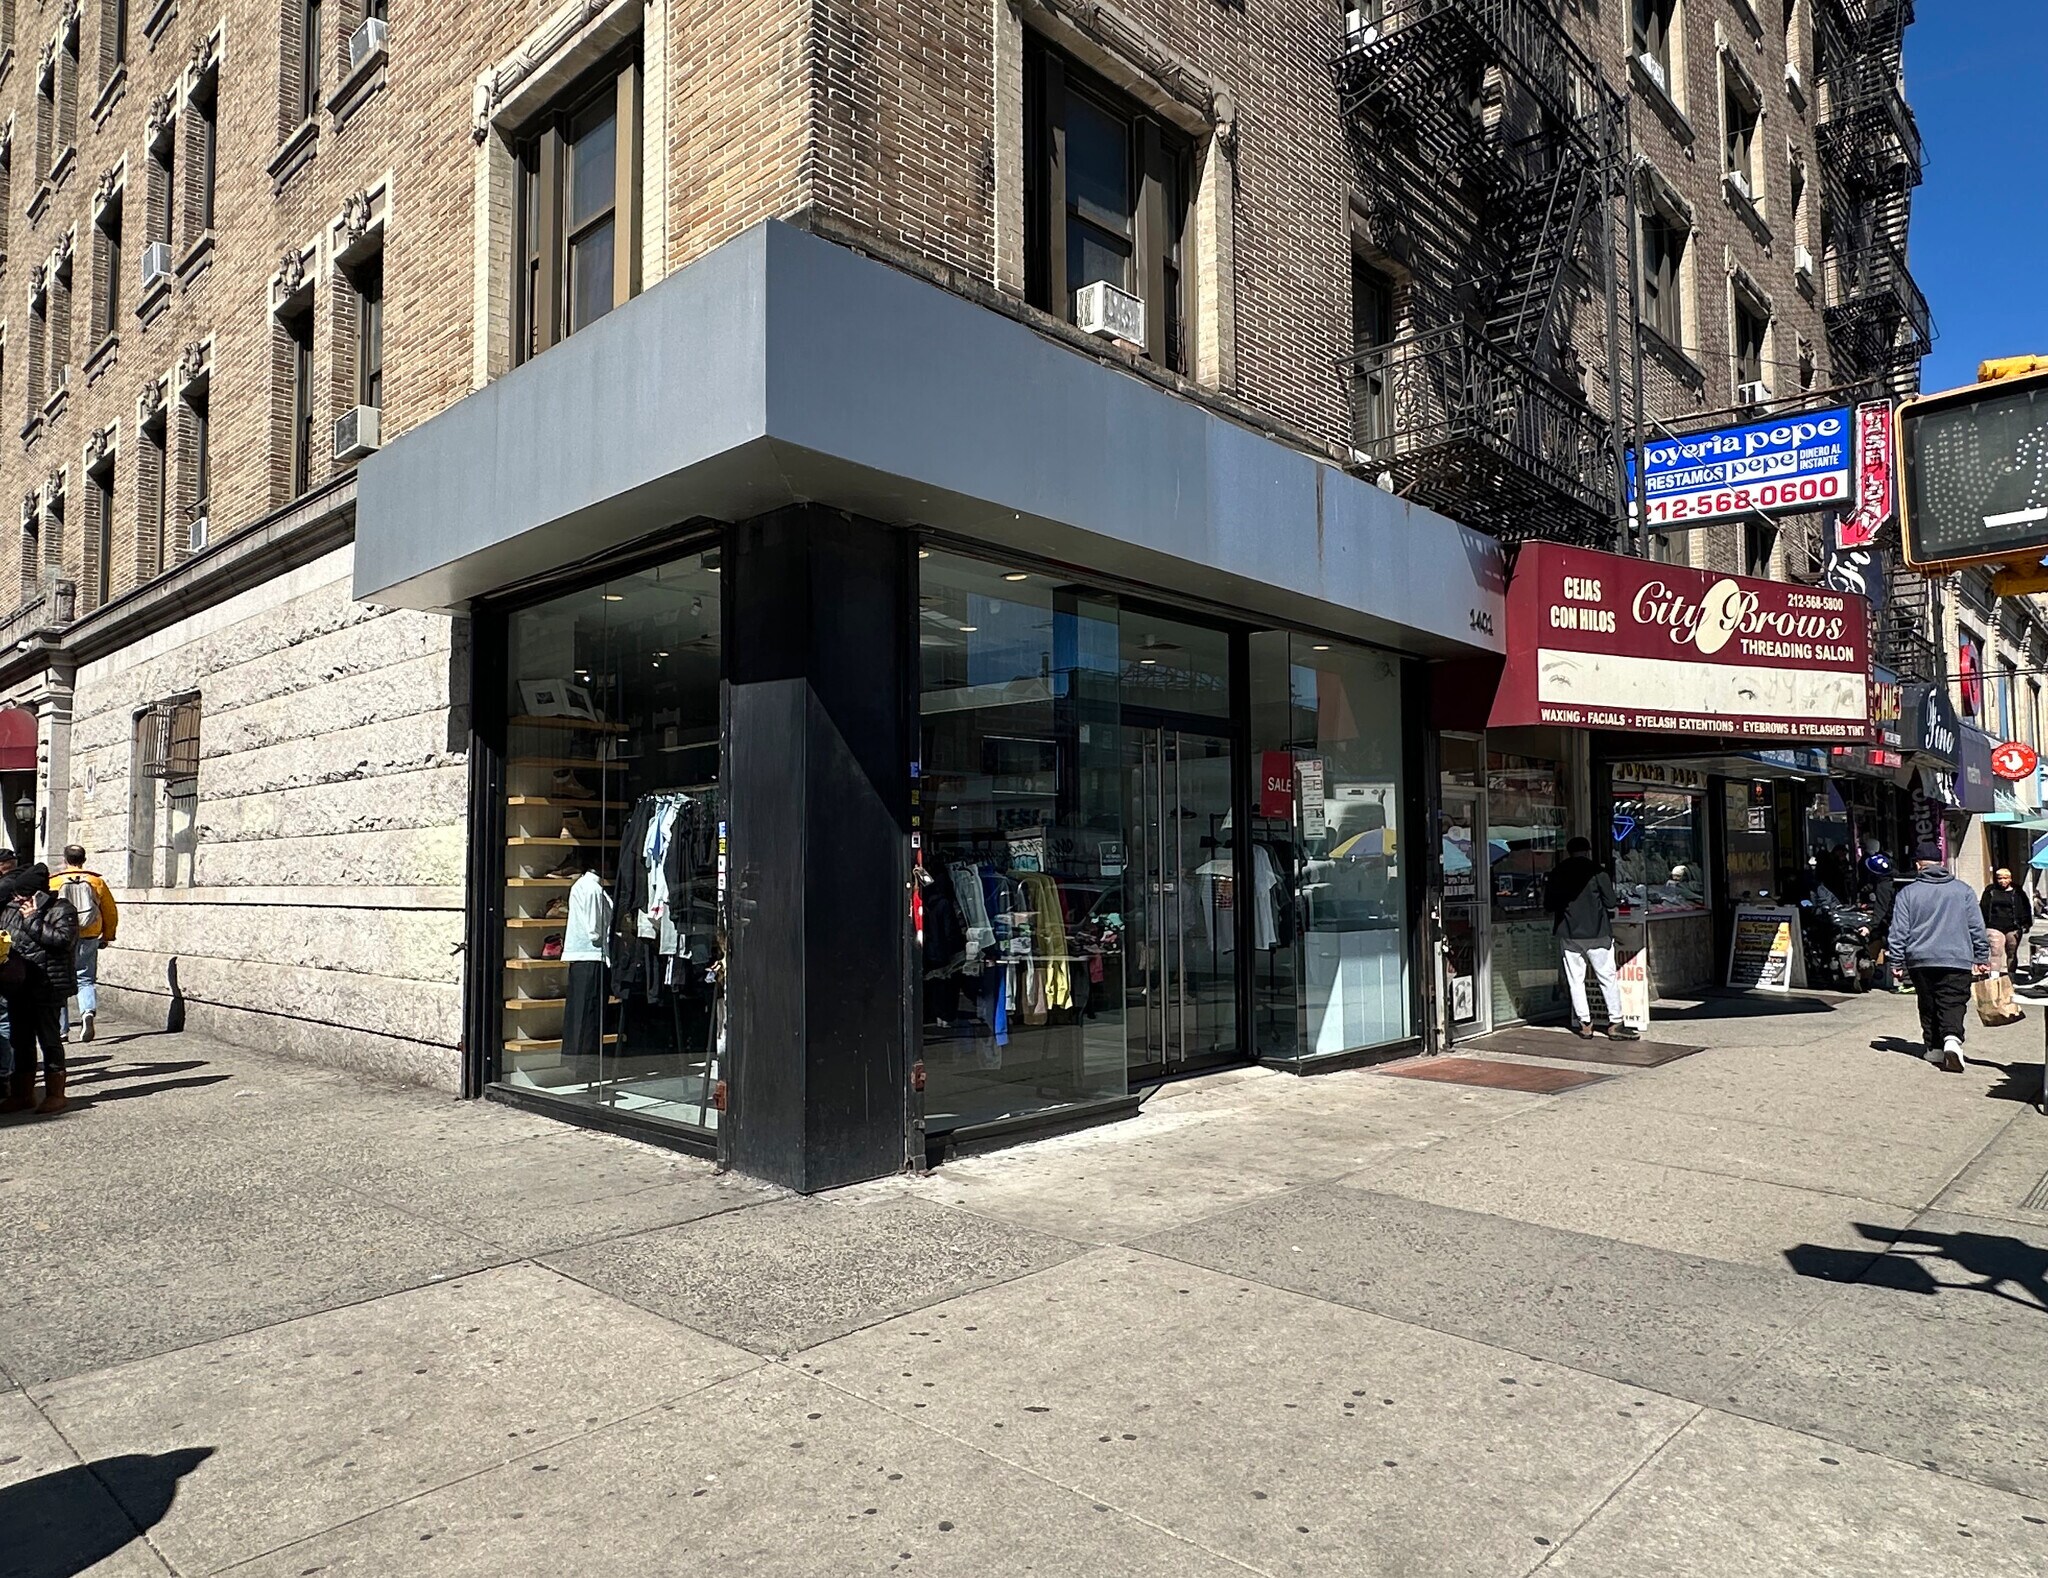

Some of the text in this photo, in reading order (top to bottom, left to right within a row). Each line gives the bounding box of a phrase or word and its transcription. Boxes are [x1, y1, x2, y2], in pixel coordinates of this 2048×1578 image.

[1746, 418, 1841, 456] pepe
[1800, 443, 1842, 460] DINERO AL
[1800, 454, 1839, 470] INSTANTE
[1645, 452, 1796, 492] RESTAMOS pepe
[1564, 576, 1602, 603] CEJAS
[1788, 593, 1844, 611] 212-568-5800
[1550, 605, 1616, 634] CON HILOS
[1632, 581, 1847, 645] City Brows
[1740, 639, 1854, 662] THREADING SALON
[1541, 709, 1865, 737] WAXING FACIALS EYELASH EXTENTIONS EYEBROWS & EYELASHES TINT
[1268, 777, 1291, 793] SALE
